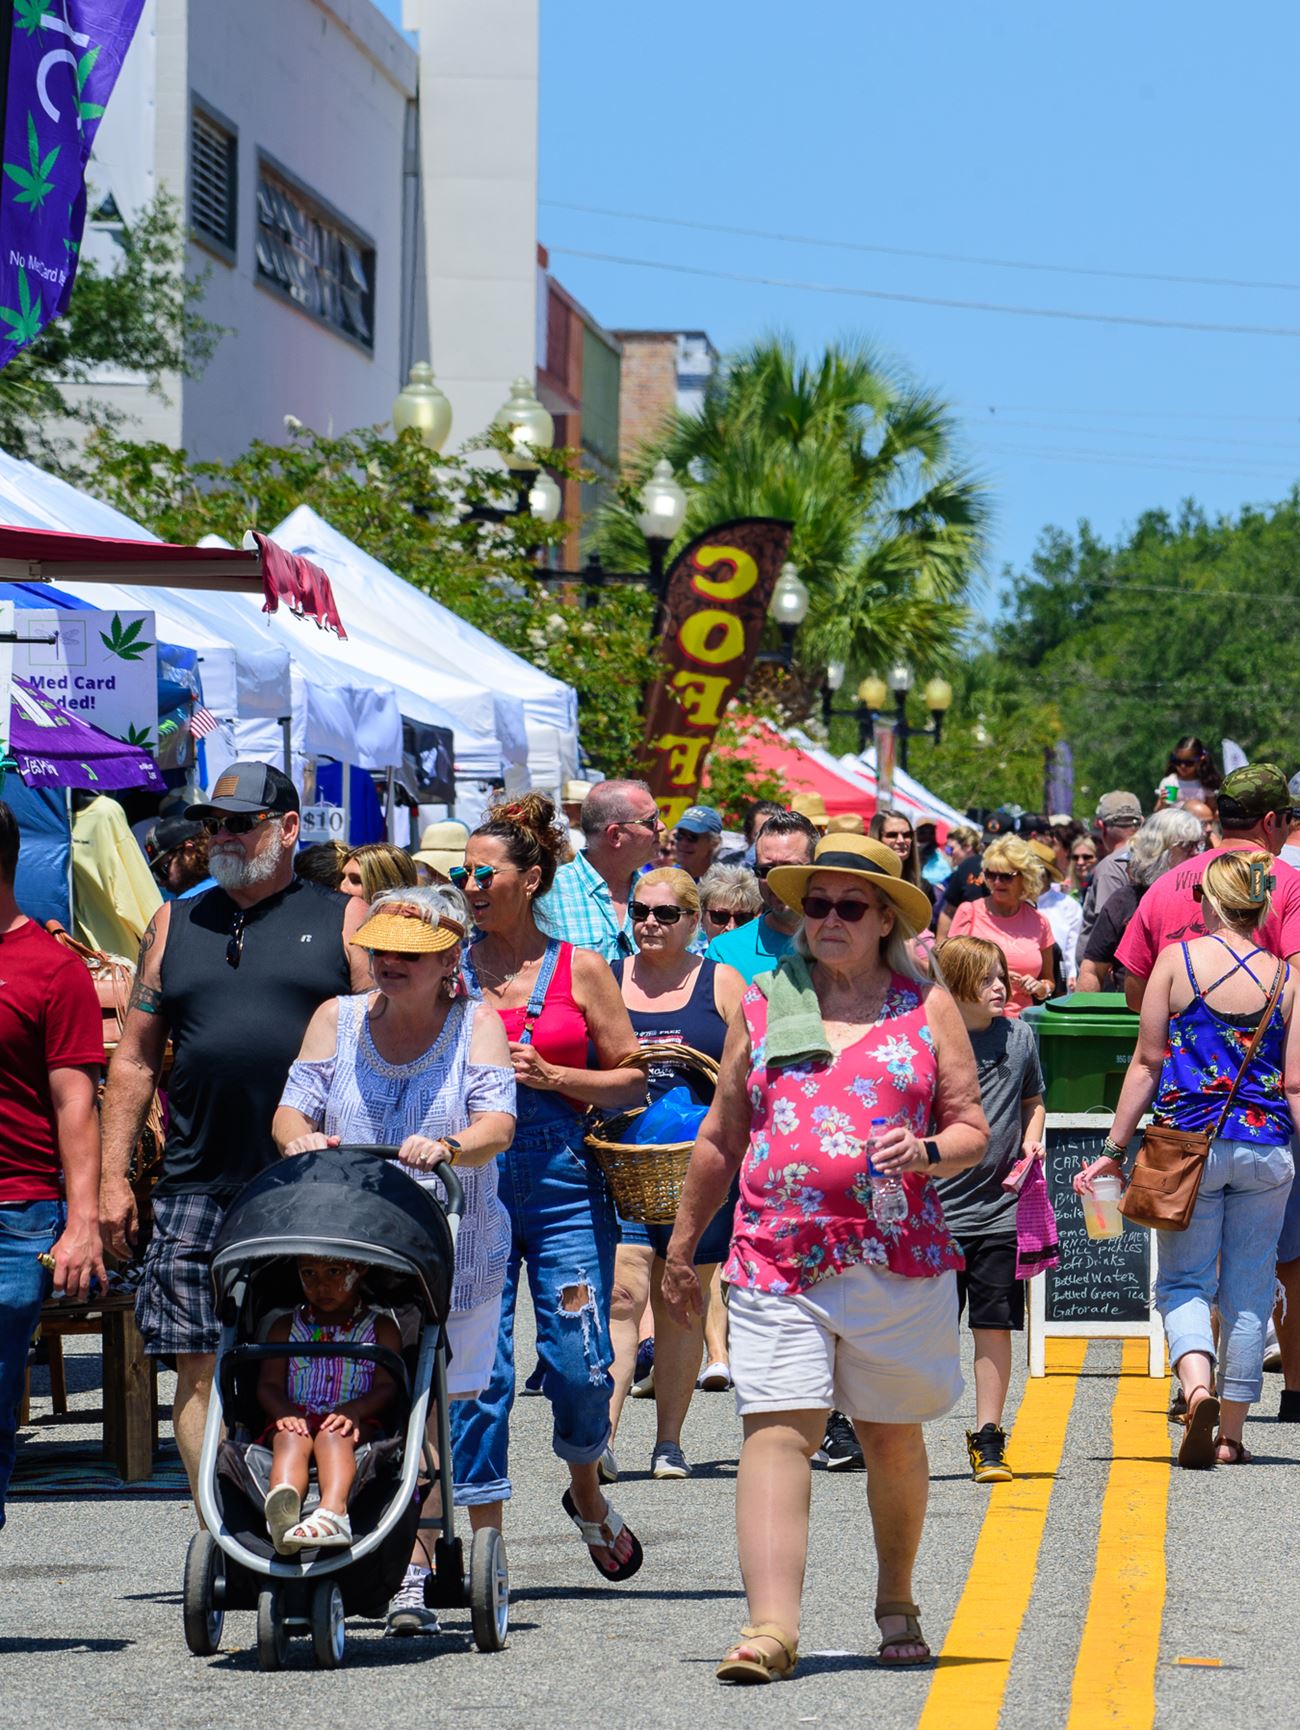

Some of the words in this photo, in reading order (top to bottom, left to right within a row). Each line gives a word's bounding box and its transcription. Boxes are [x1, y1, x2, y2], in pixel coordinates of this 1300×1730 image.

[9, 249, 25, 268] No
[30, 675, 68, 690] Med
[74, 675, 116, 690] Card
[57, 695, 95, 709] ded!
[303, 811, 343, 831] $10
[1175, 870, 1203, 892] WIN
[1064, 1246, 1092, 1258] DILL
[1098, 1243, 1143, 1255] PICKLES
[1085, 1253, 1126, 1269] Drinks
[1090, 1287, 1120, 1301] Green
[1123, 1286, 1148, 1301] Tea
[1053, 1303, 1127, 1318] Gatorade
